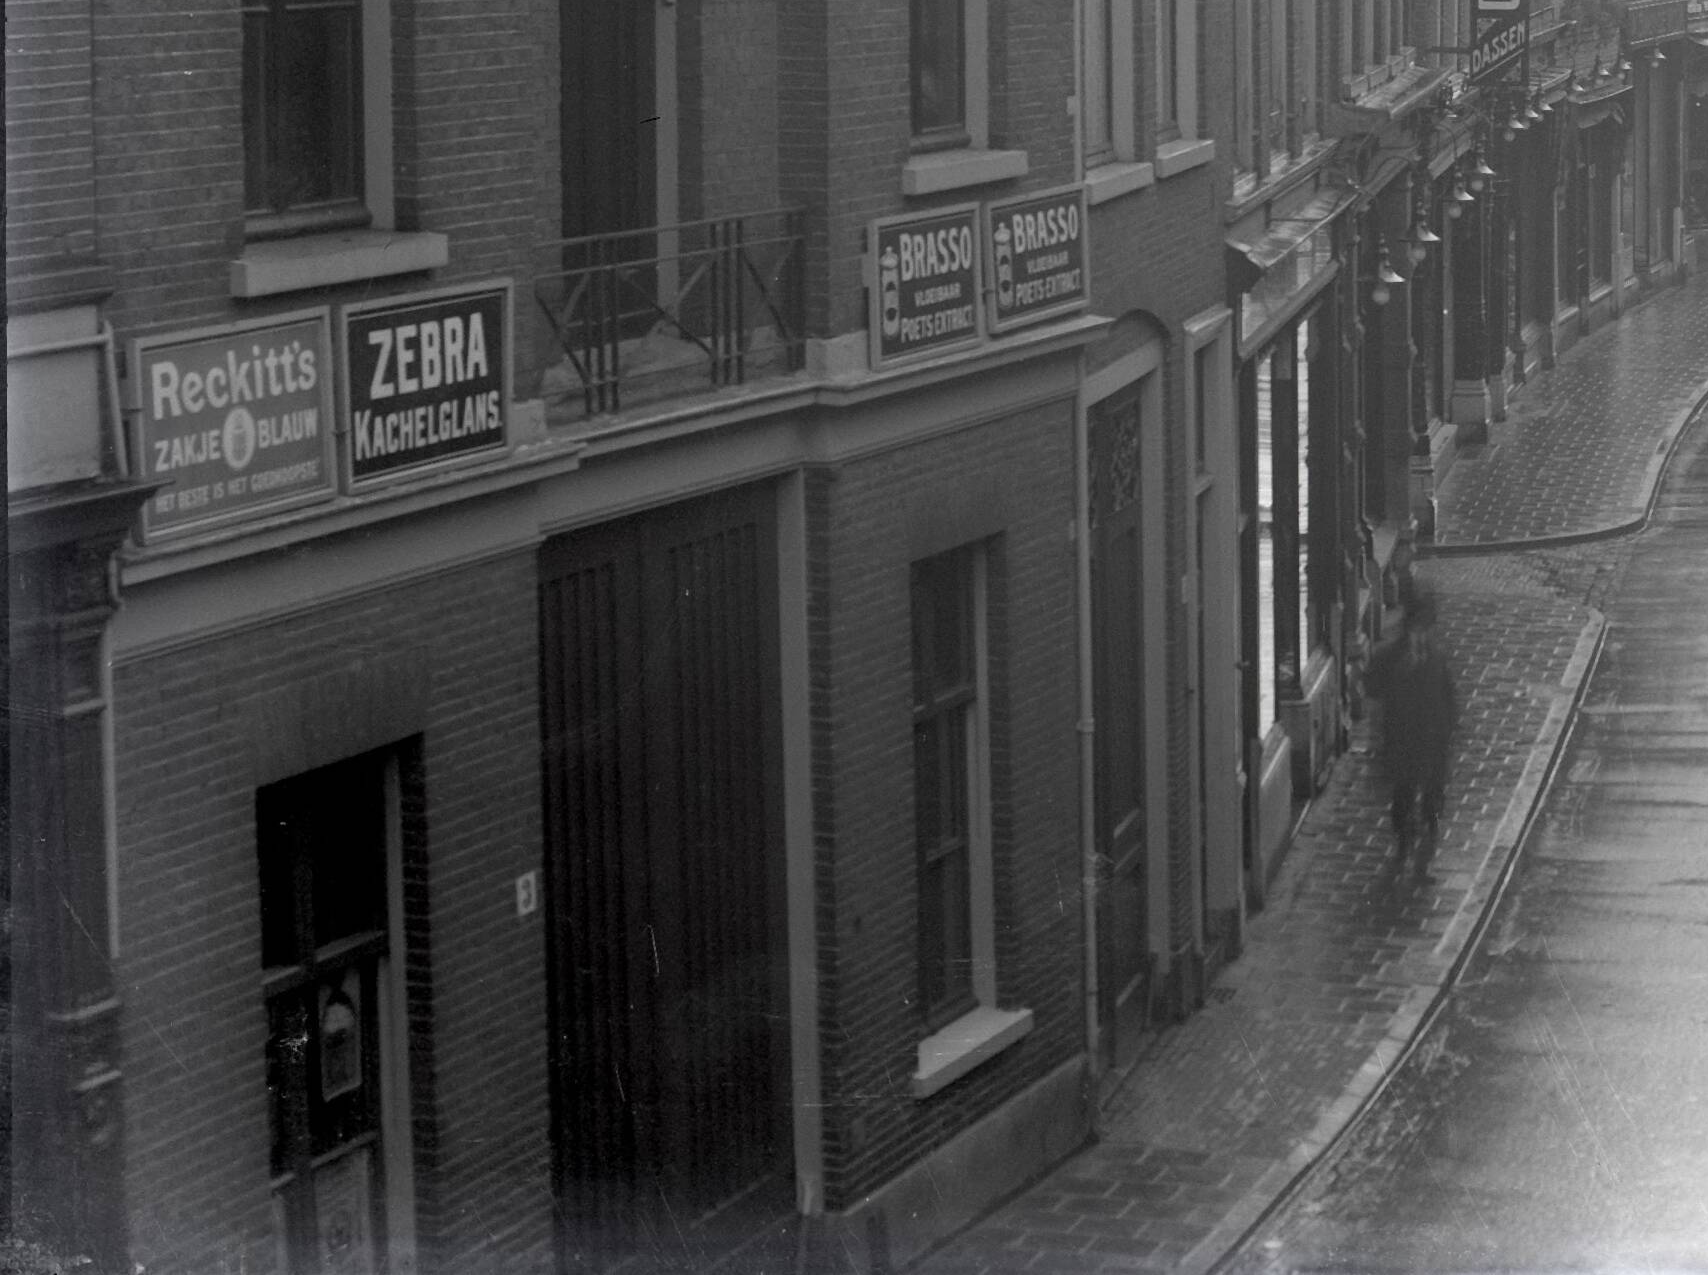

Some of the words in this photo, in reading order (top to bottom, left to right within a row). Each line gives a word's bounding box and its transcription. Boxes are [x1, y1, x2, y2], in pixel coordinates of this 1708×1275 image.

[1472, 19, 1526, 75] DASSEN
[898, 225, 973, 282] BRASSO
[1011, 203, 1080, 255] BRASSO
[150, 340, 318, 421] Reckitt's
[367, 311, 489, 401] ZEBRA
[153, 428, 222, 473] ZAKJE
[256, 406, 319, 450] BLAUW
[211, 481, 225, 500] IS
[226, 476, 248, 496] HET
